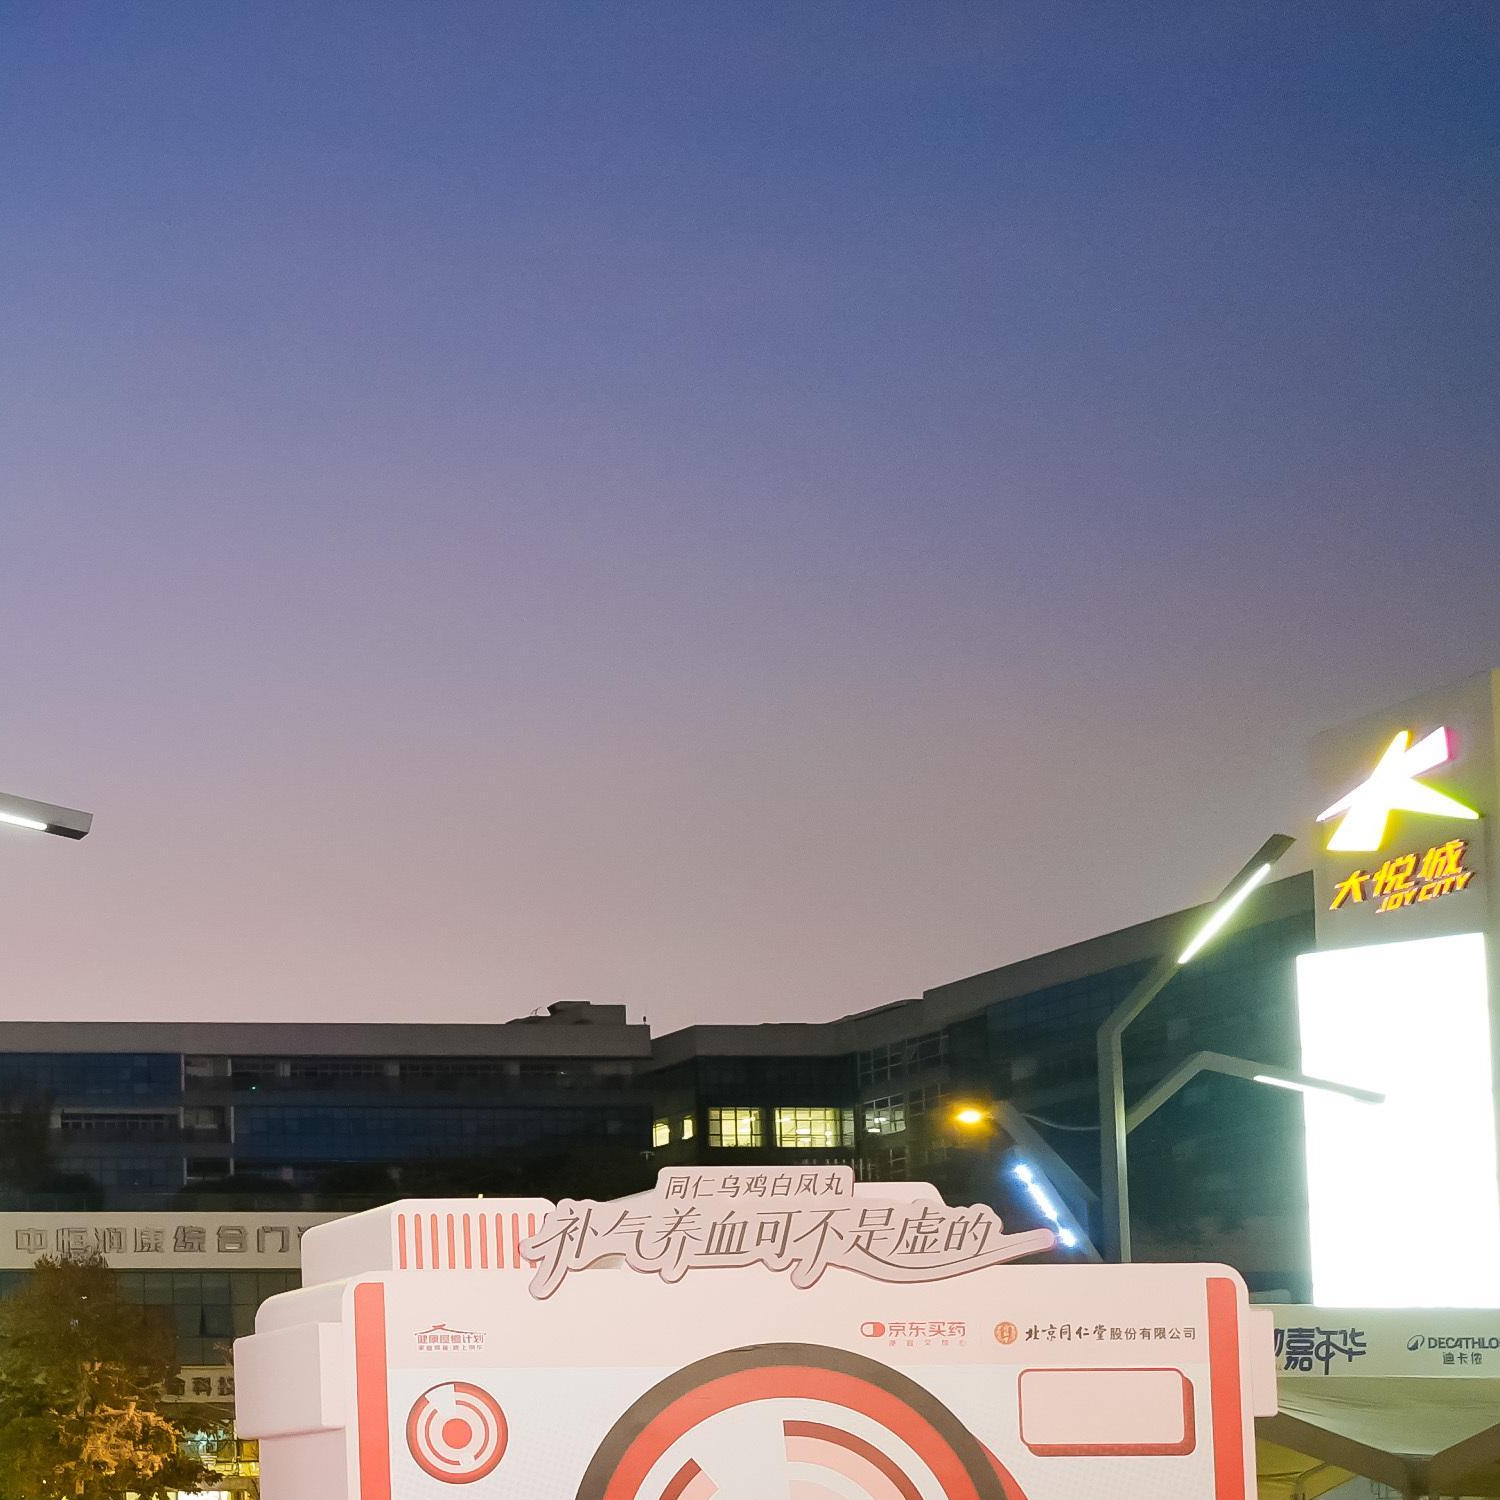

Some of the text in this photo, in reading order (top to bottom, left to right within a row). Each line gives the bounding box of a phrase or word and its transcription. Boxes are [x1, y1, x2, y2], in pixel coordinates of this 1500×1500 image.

[1329, 838, 1467, 911] 大悦城
[1376, 871, 1472, 914] JOY CITY
[665, 1173, 844, 1200] 同仁乌鸡白凤丸
[530, 1205, 996, 1272] 补气养血可不是虚的
[888, 1321, 967, 1338] 京东买药
[1025, 1322, 1197, 1341] 北京同仁堂股份有限公司
[1427, 1336, 1500, 1350] DECATHLO
[1442, 1352, 1483, 1366] 迪卡侬
